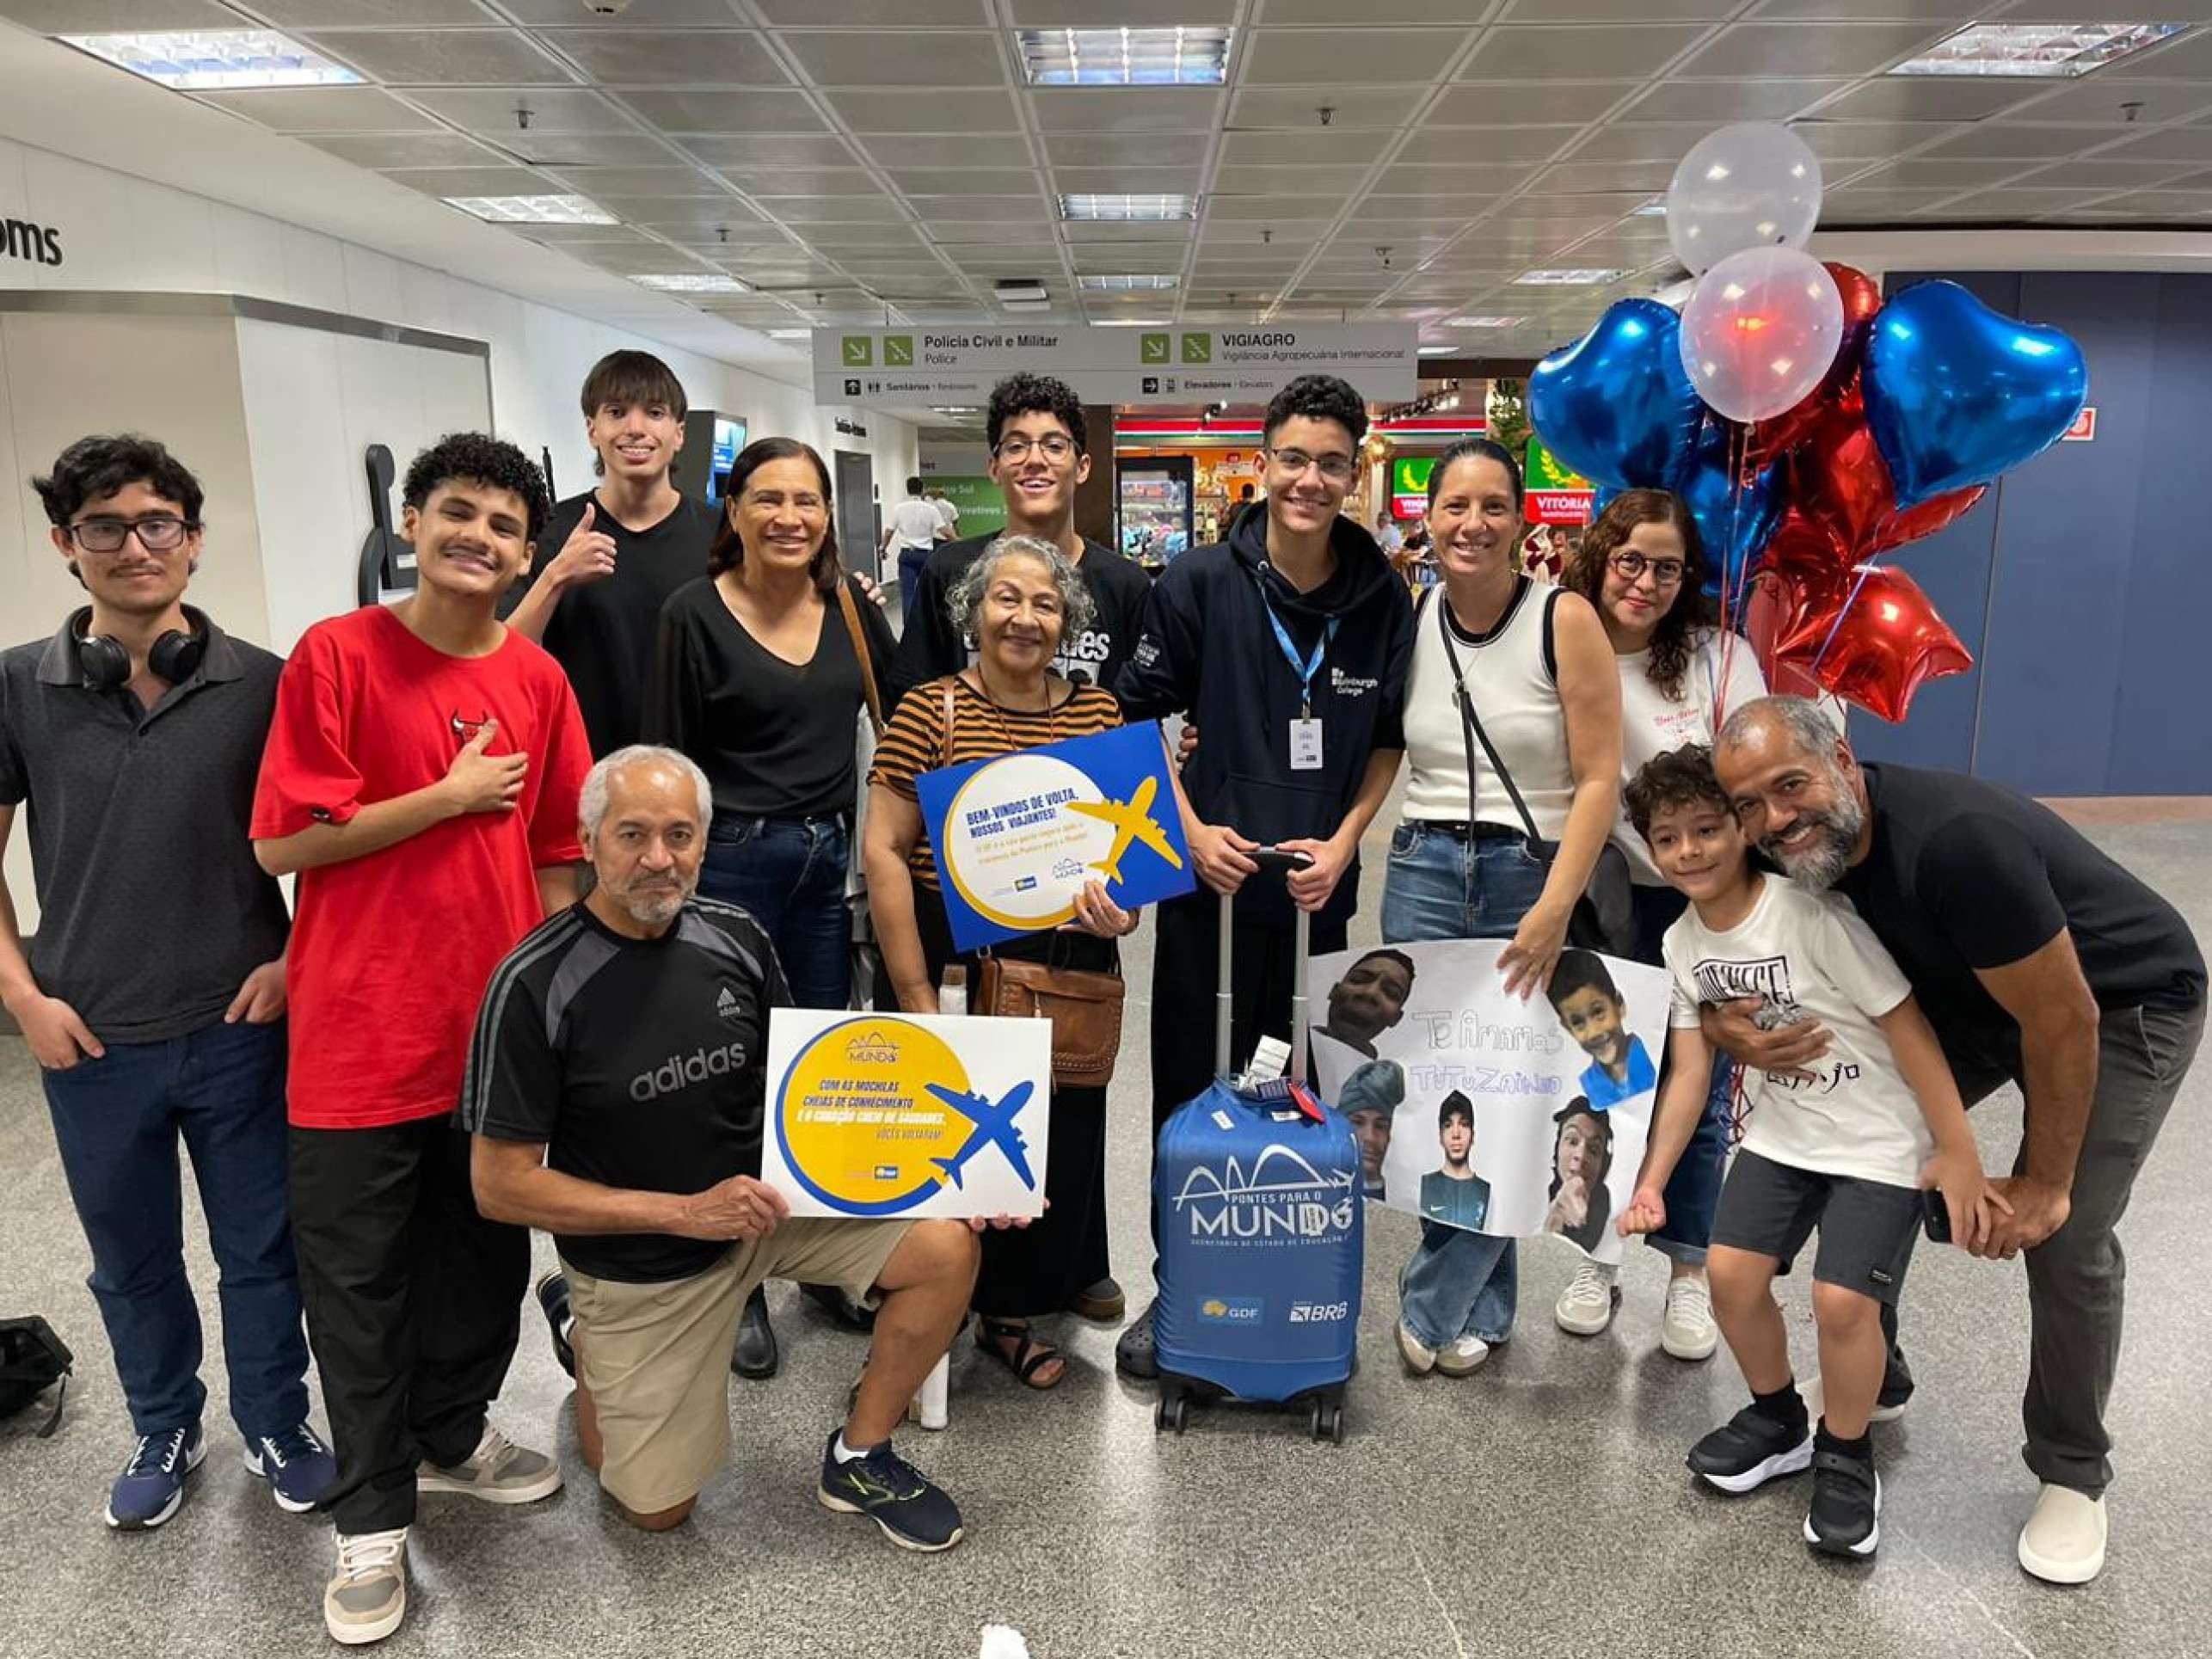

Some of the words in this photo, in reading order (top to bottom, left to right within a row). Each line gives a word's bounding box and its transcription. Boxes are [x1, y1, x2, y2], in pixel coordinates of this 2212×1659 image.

[973, 334, 1003, 347] Civil
[1005, 338, 1014, 347] e
[1017, 334, 1058, 347] Militar
[1222, 333, 1295, 347] VIGIAGRO
[925, 353, 957, 365] Police
[966, 800, 1029, 826] BEM-VINDOS
[1029, 795, 1045, 809] DE
[969, 820, 1005, 839] NOSSOS
[630, 1042, 747, 1102] adidas
[1231, 1193, 1276, 1204] PONTES
[1280, 1190, 1311, 1202] PARA
[1314, 1190, 1322, 1201] O
[1191, 1197, 1355, 1237] MUNDO
[1228, 1307, 1259, 1318] GDF
[1311, 1300, 1349, 1322] BRB
